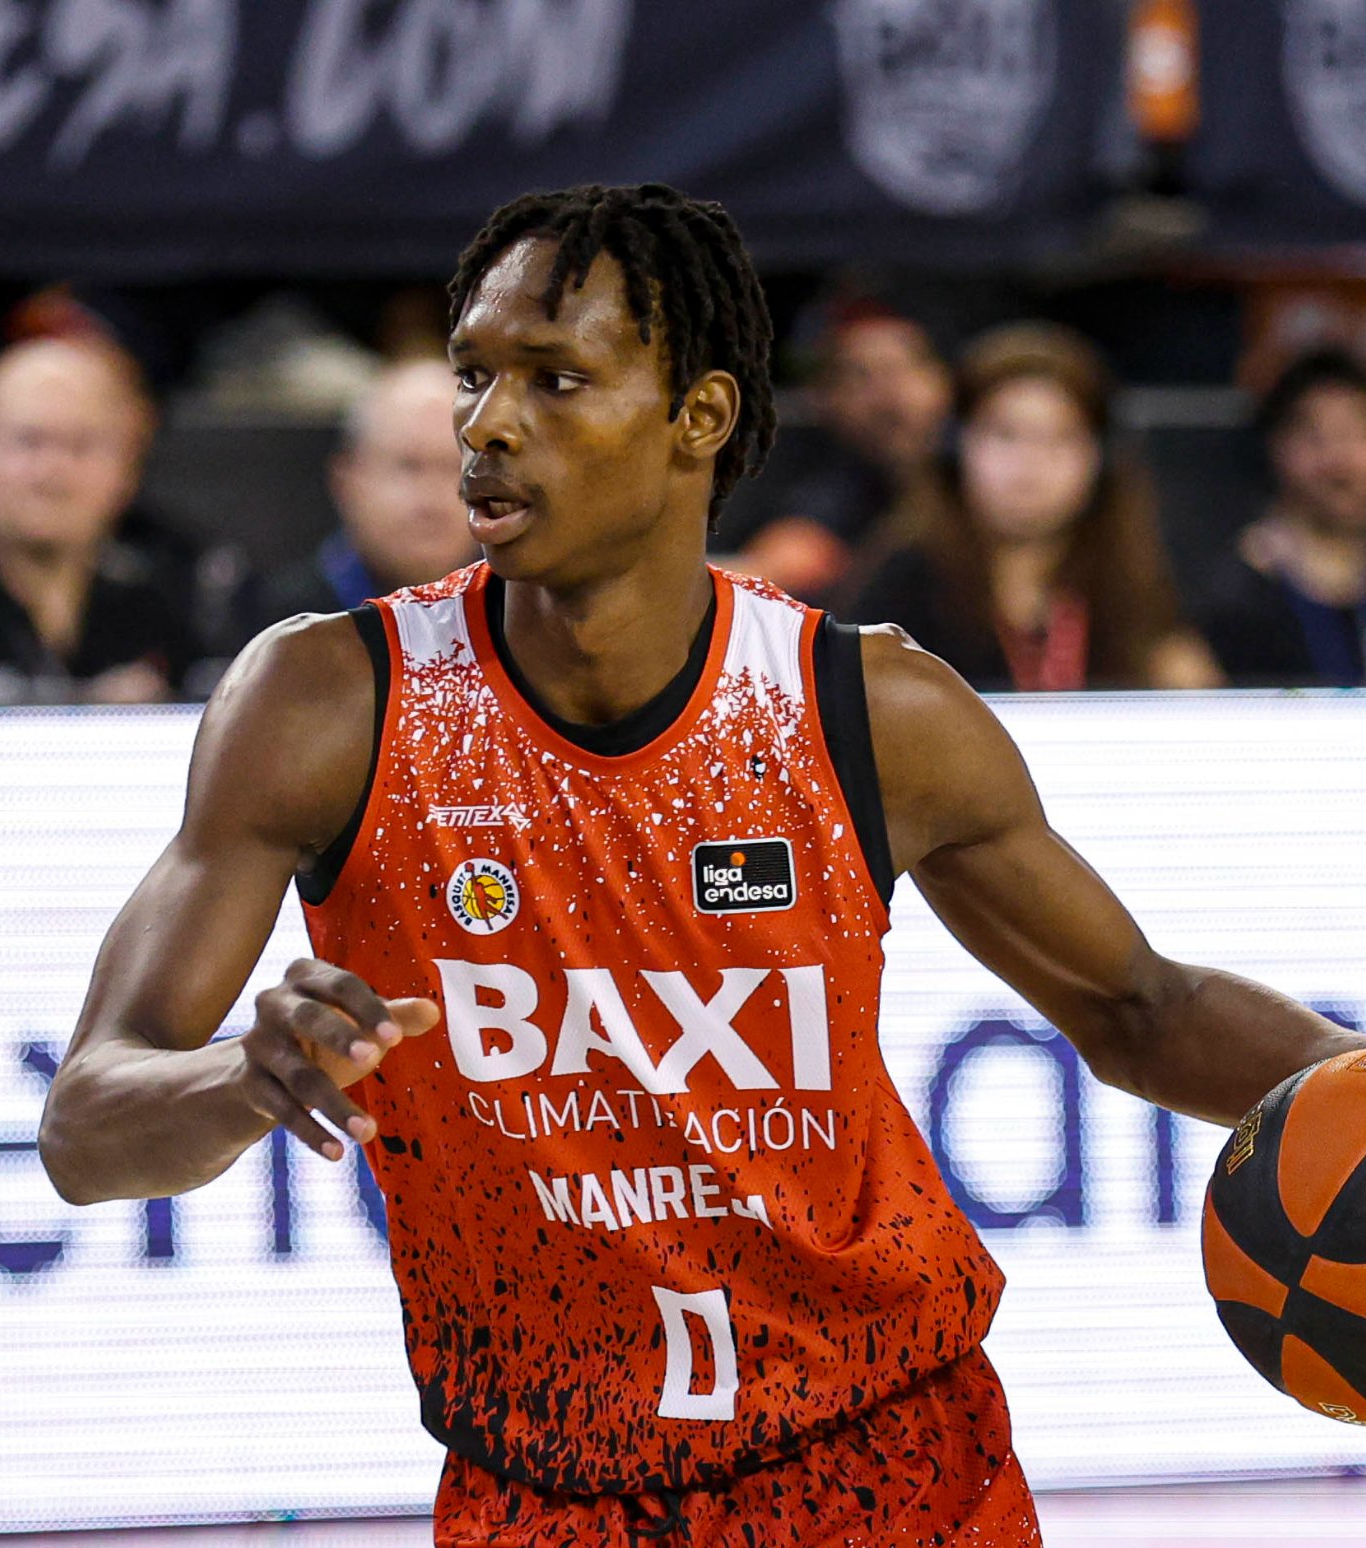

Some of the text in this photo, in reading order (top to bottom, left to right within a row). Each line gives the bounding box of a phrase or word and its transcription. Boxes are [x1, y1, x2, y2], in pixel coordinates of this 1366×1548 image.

[703, 864, 743, 886] liga
[704, 881, 788, 903] endesa
[432, 956, 833, 1096] BAXI
[468, 1088, 837, 1155] CLIMATIACIÓN
